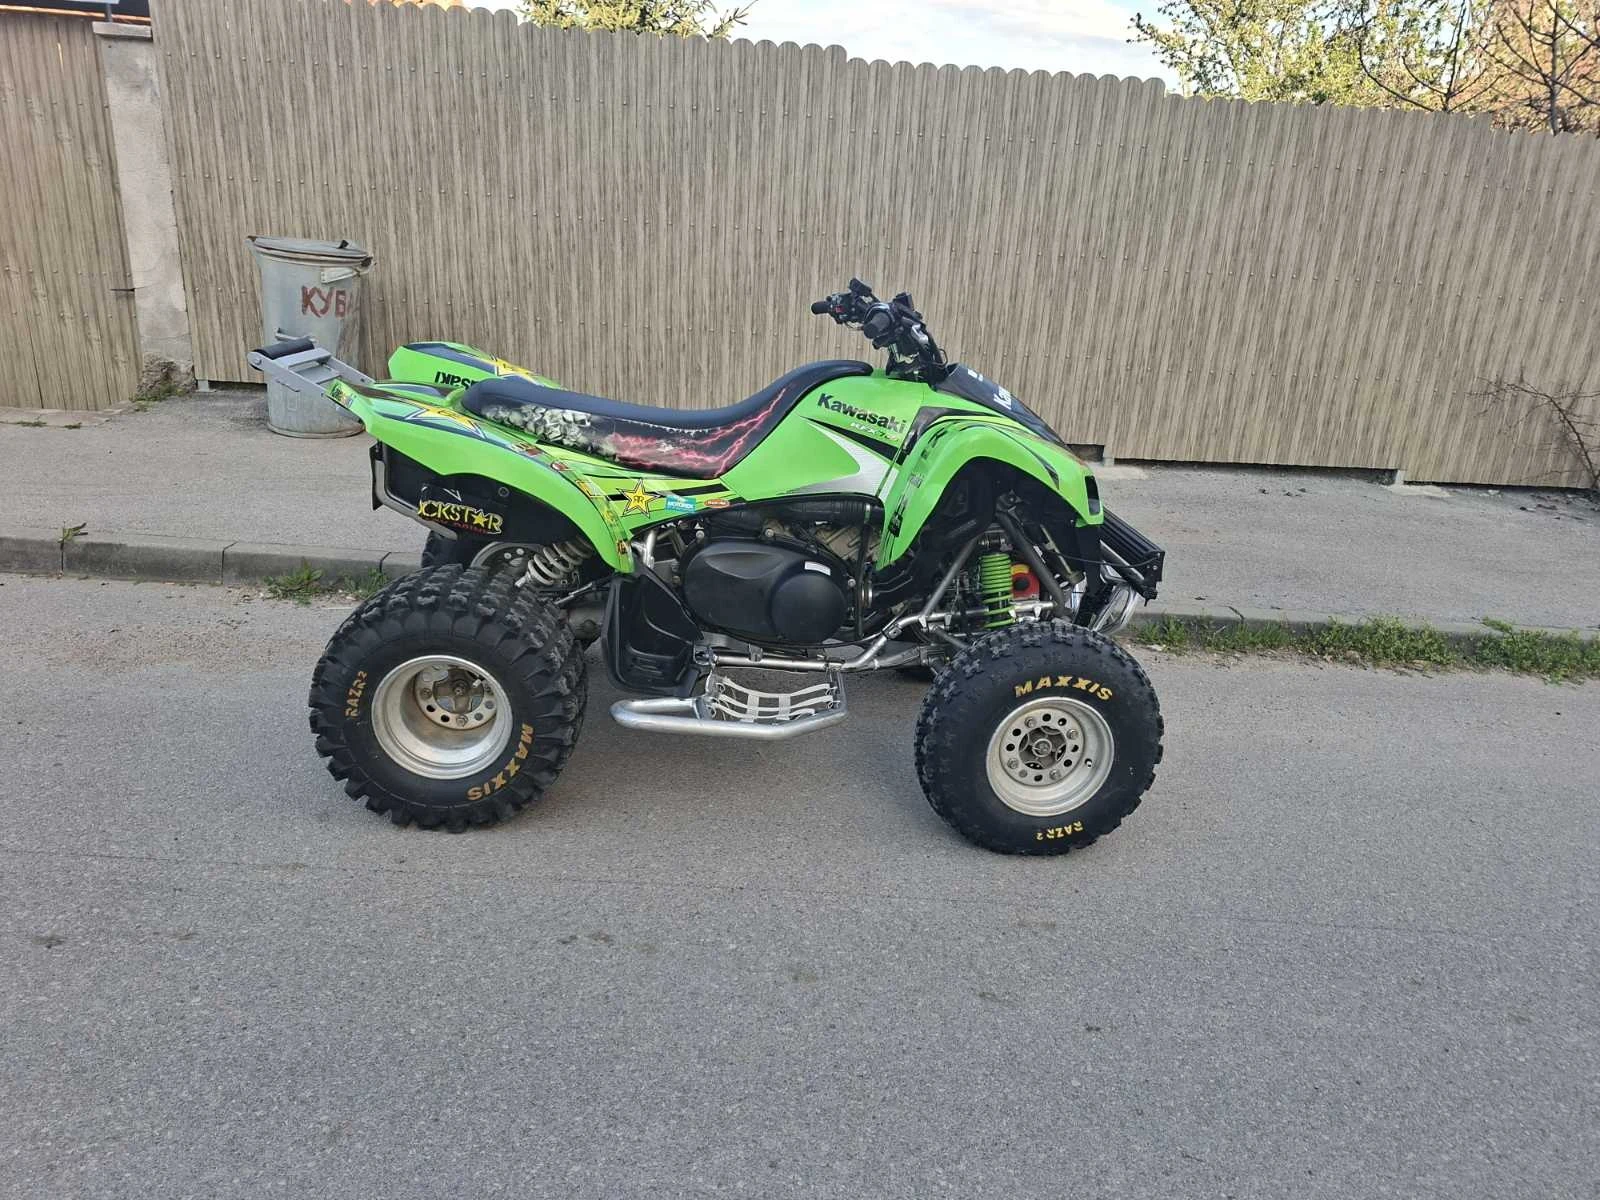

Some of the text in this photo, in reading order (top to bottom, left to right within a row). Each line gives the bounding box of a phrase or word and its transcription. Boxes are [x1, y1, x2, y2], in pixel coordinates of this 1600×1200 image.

[817, 393, 907, 433] Kawasaki
[1014, 675, 1113, 701] MAXXIS
[467, 723, 535, 801] MAXXIS
